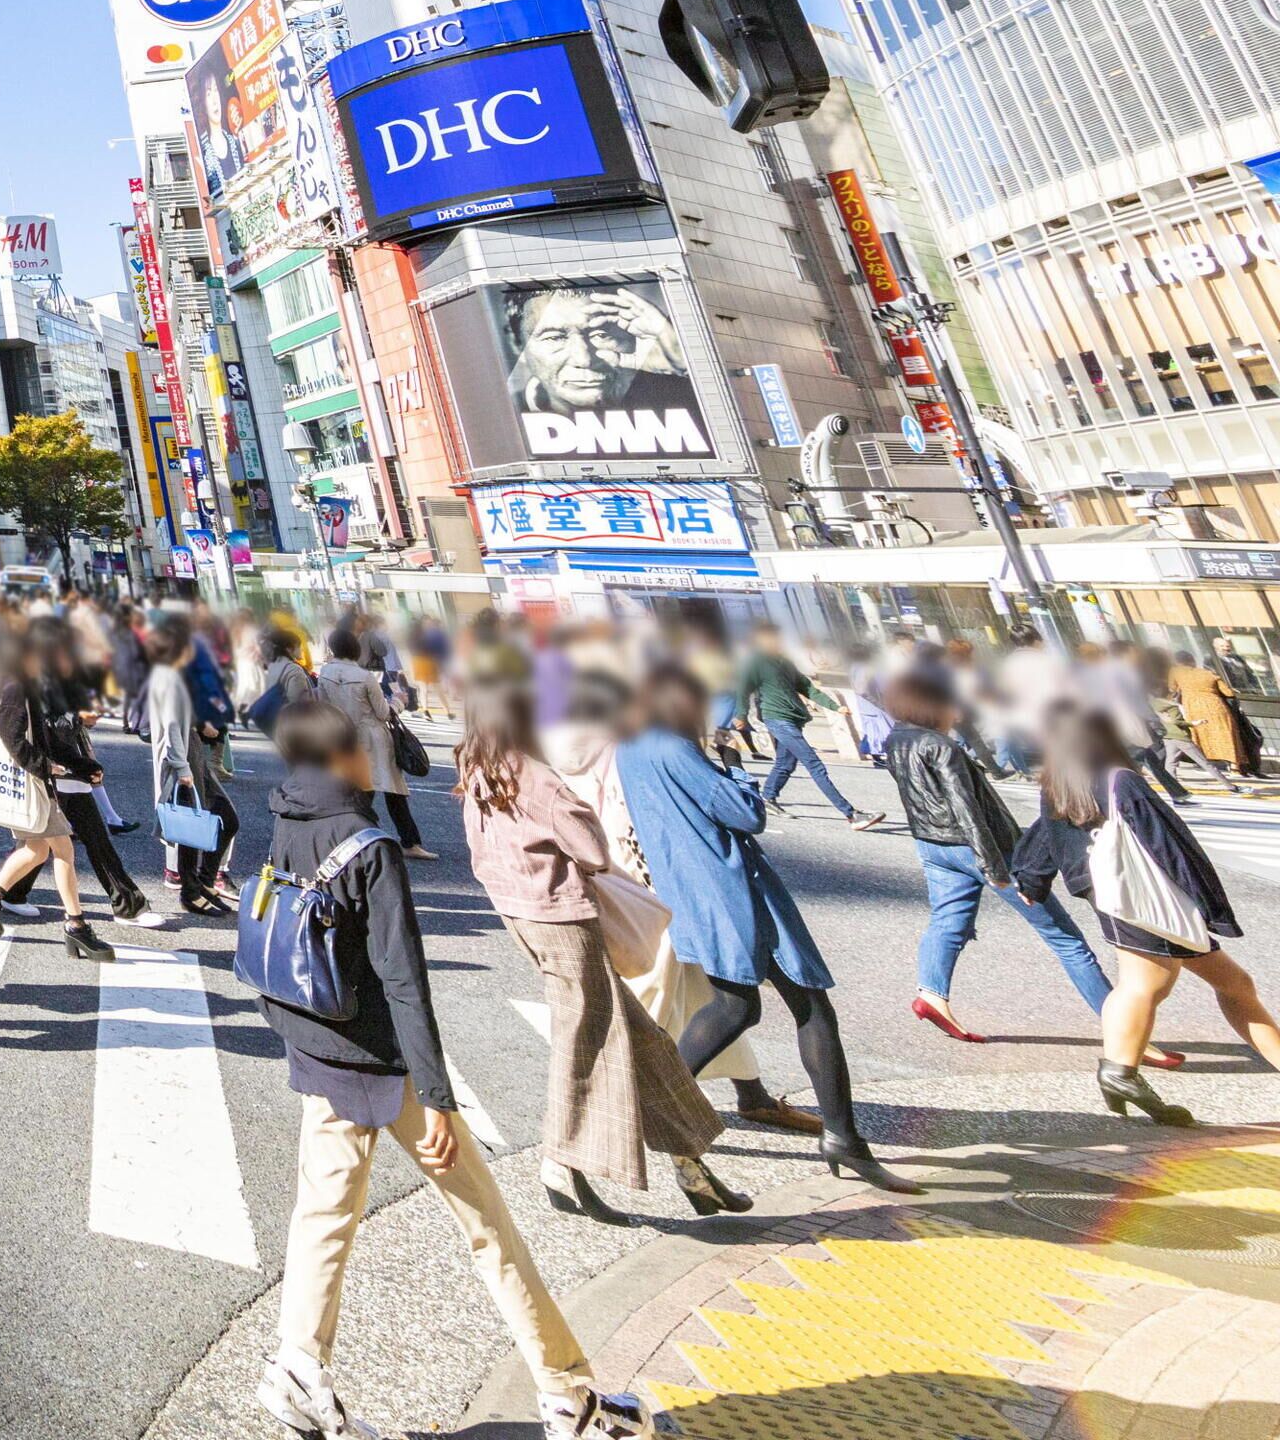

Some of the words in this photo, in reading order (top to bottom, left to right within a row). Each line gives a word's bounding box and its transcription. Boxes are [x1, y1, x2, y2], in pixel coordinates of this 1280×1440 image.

[385, 20, 466, 64] DHC
[375, 87, 550, 176] DHC
[436, 206, 461, 221] DHC
[463, 197, 515, 218] Channel
[0, 222, 48, 254] H&M
[835, 176, 893, 291] クスリのことなら
[521, 409, 711, 456] DMM
[486, 495, 715, 535] 大盛堂書店
[643, 566, 698, 576] TAISEIDO
[1203, 561, 1255, 576] 渋谷駅
